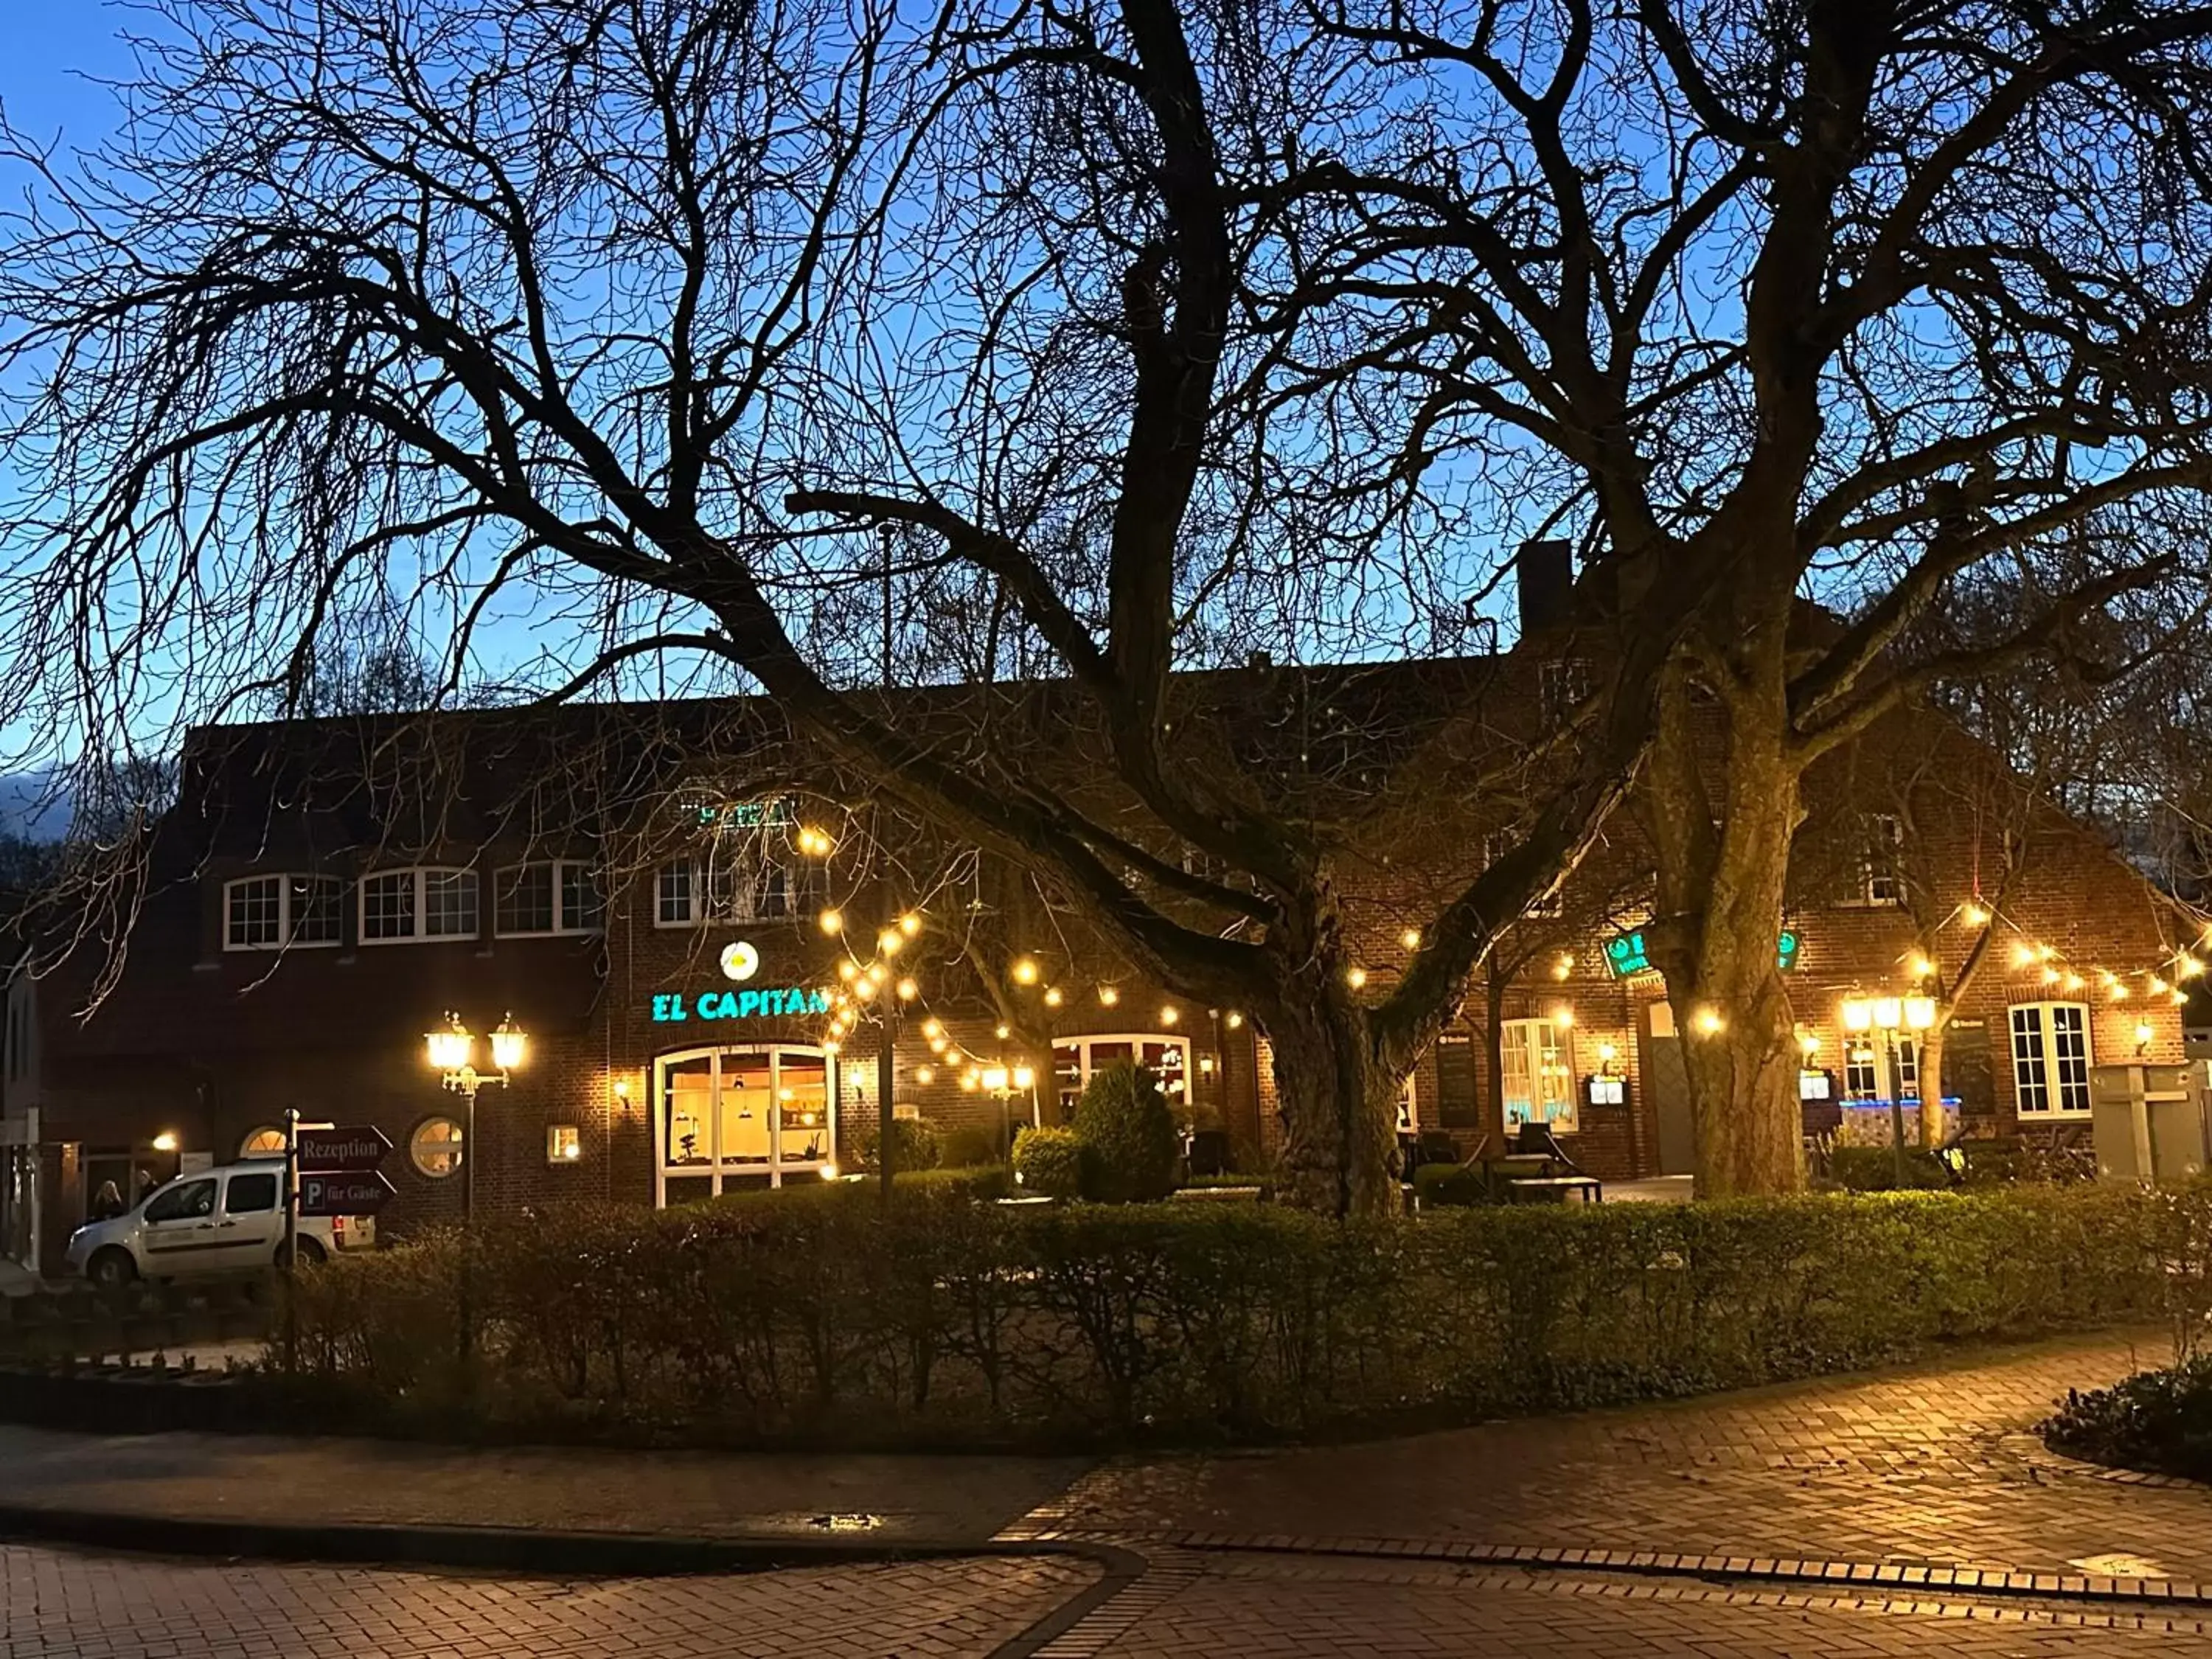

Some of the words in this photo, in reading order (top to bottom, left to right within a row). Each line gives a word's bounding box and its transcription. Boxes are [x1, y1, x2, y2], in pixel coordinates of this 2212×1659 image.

[653, 994, 687, 1021] EL
[304, 1138, 378, 1163] Rezeption
[308, 1183, 321, 1205] P
[327, 1186, 344, 1201] für
[347, 1185, 380, 1201] Gäste
